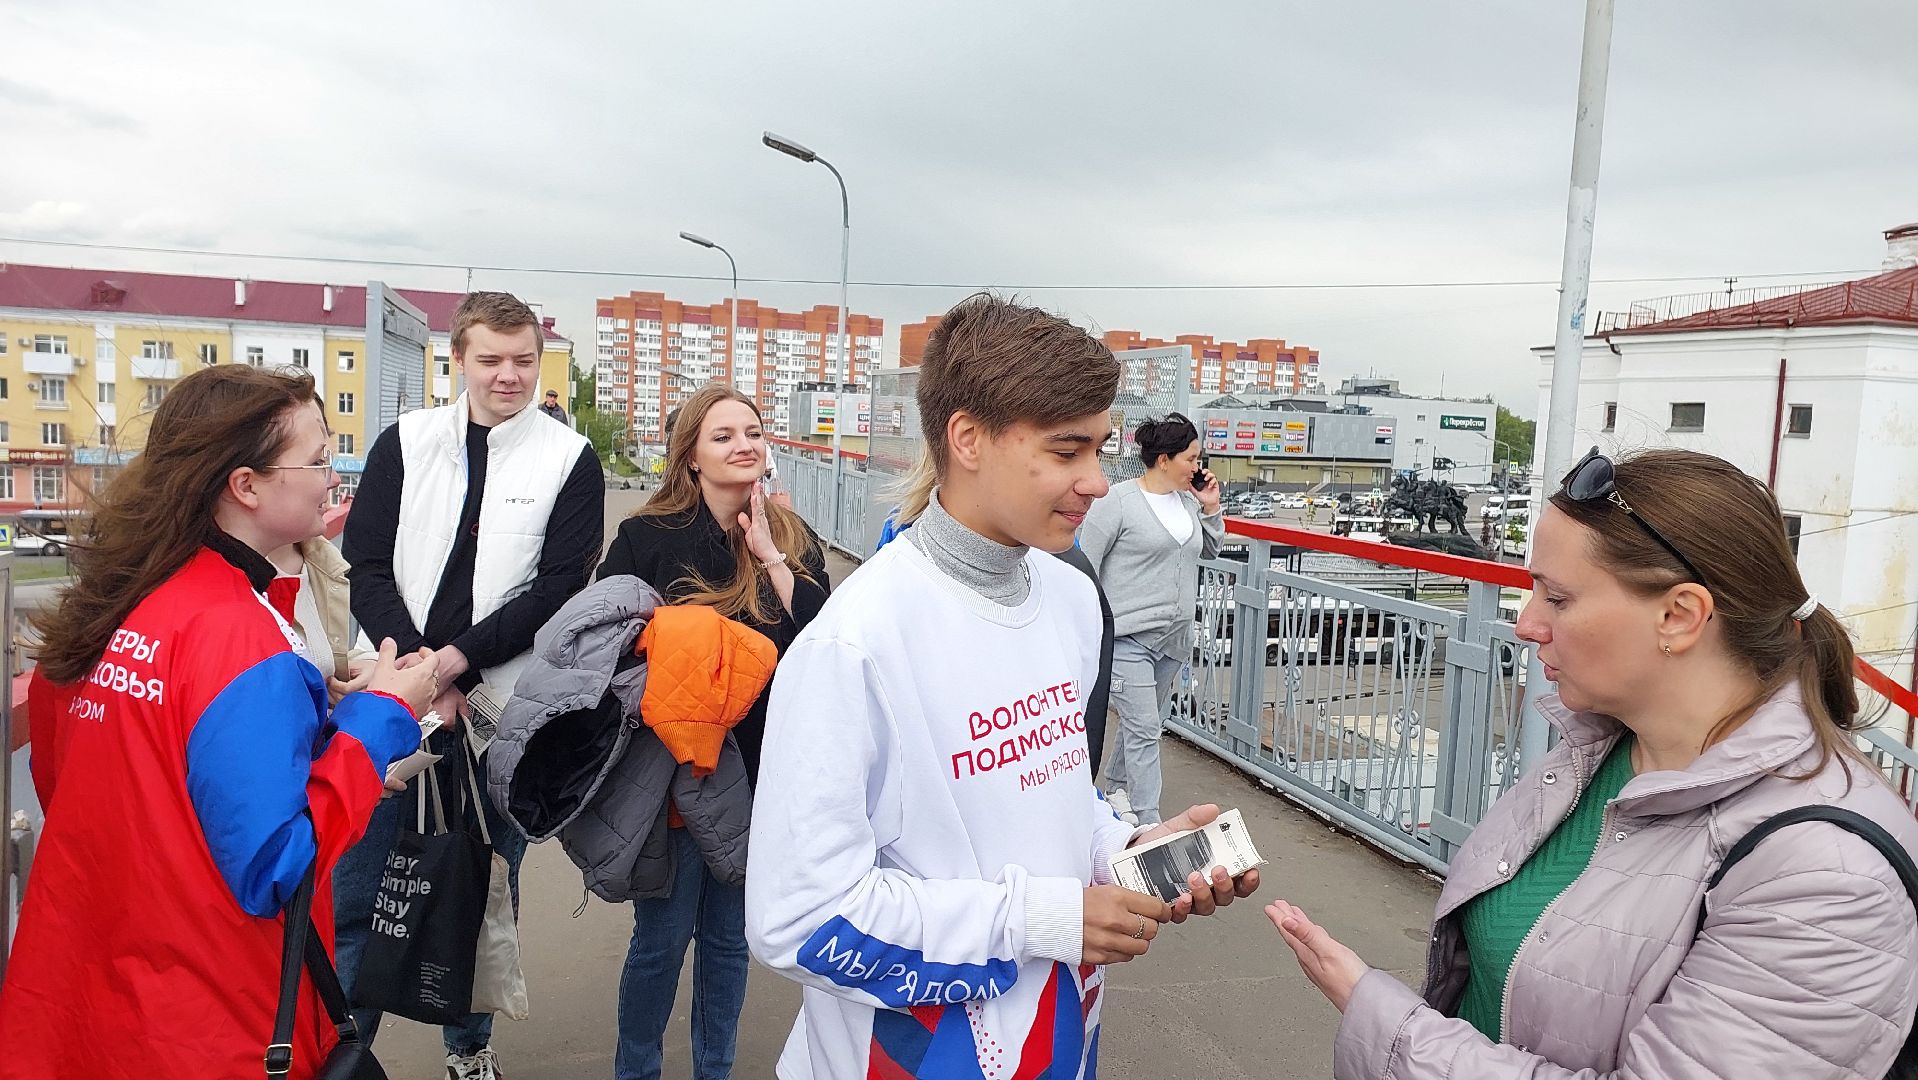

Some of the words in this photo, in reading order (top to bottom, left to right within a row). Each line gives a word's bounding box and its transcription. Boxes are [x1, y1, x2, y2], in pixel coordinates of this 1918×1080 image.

[1019, 764, 1051, 792] МЫ
[375, 891, 411, 919] Stay
[370, 912, 410, 940] True.
[815, 935, 881, 981] МЫ
